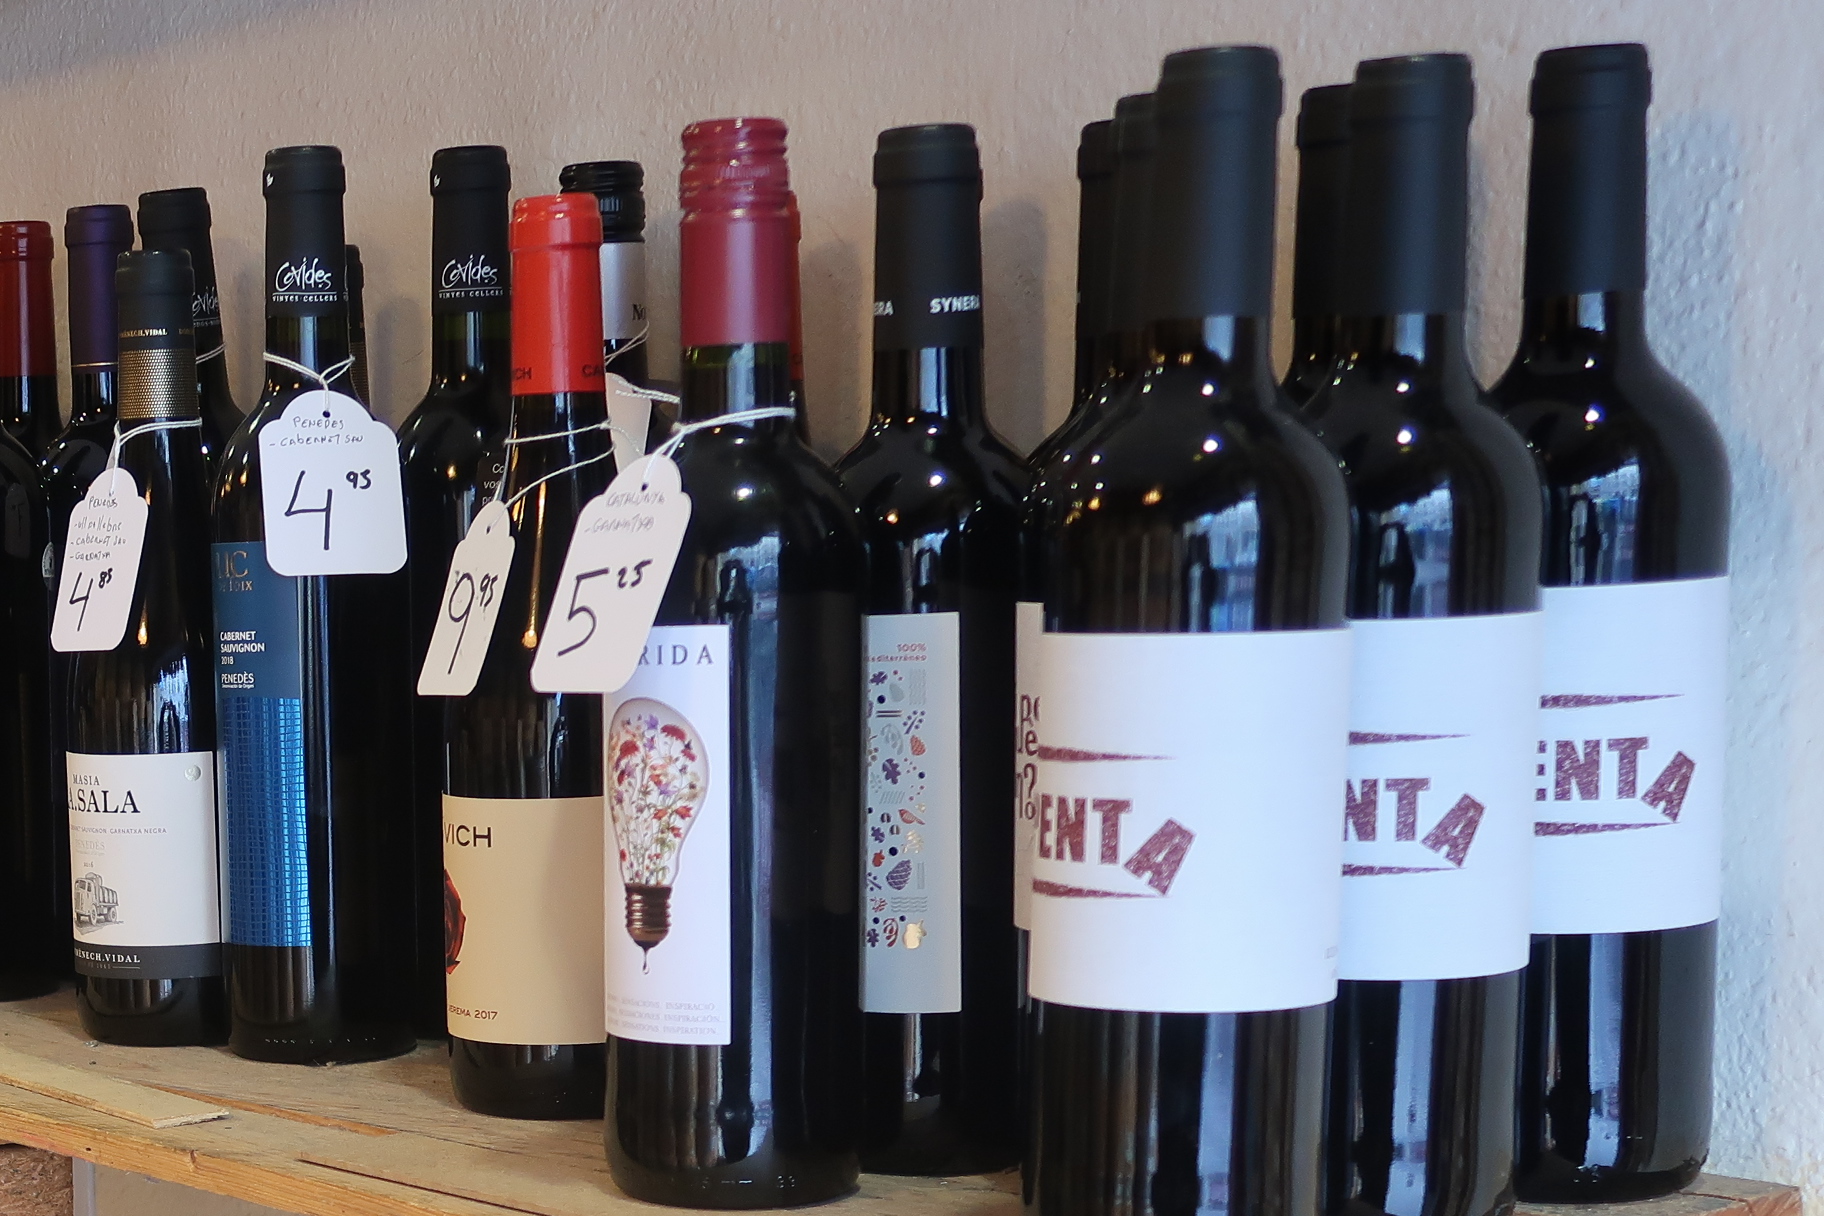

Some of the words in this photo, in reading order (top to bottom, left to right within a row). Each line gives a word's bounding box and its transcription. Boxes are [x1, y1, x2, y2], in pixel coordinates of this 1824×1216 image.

[276, 257, 331, 290] Covides
[441, 254, 498, 288] Covides
[220, 631, 257, 641] CABERNET
[220, 643, 265, 653] SAUVIGNON
[897, 643, 926, 653] 100%
[221, 671, 255, 684] PENEDÈS
[73, 774, 100, 786] MASIA
[474, 1010, 498, 1021] 2017
